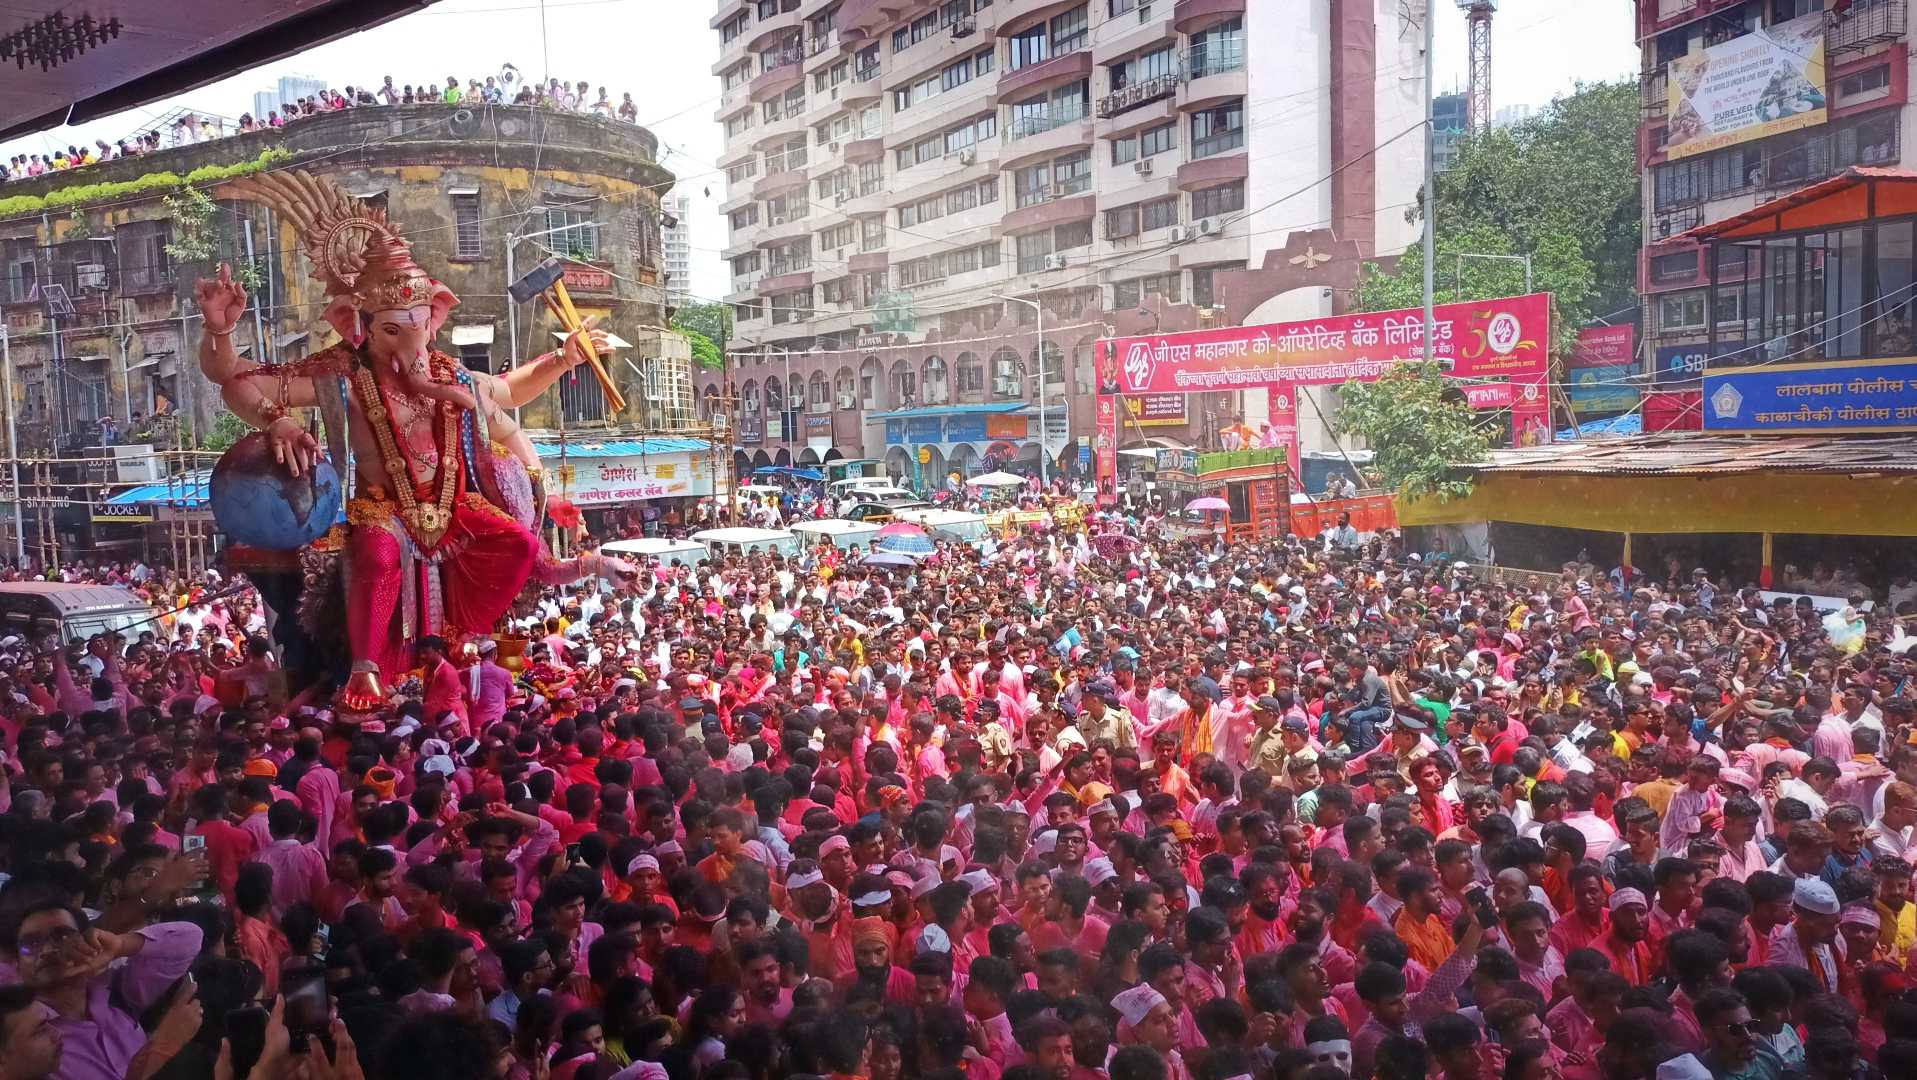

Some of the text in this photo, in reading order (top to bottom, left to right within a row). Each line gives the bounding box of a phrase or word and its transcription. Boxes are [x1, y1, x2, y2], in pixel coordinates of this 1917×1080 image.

[1714, 104, 1753, 120] PURE VEG
[1194, 339, 1249, 360] महानगर
[1351, 319, 1379, 348] बँक
[1684, 353, 1708, 372] SBI
[1776, 383, 1843, 398] लालबाग
[1847, 378, 1904, 393] पोलीस
[1755, 404, 1833, 423] काळाचौकी
[1838, 405, 1890, 420] पोलीस
[26, 495, 70, 508] SAMUNG
[579, 487, 611, 501] गणेश
[615, 487, 643, 499] कलर
[104, 504, 140, 516] JOCKEY
